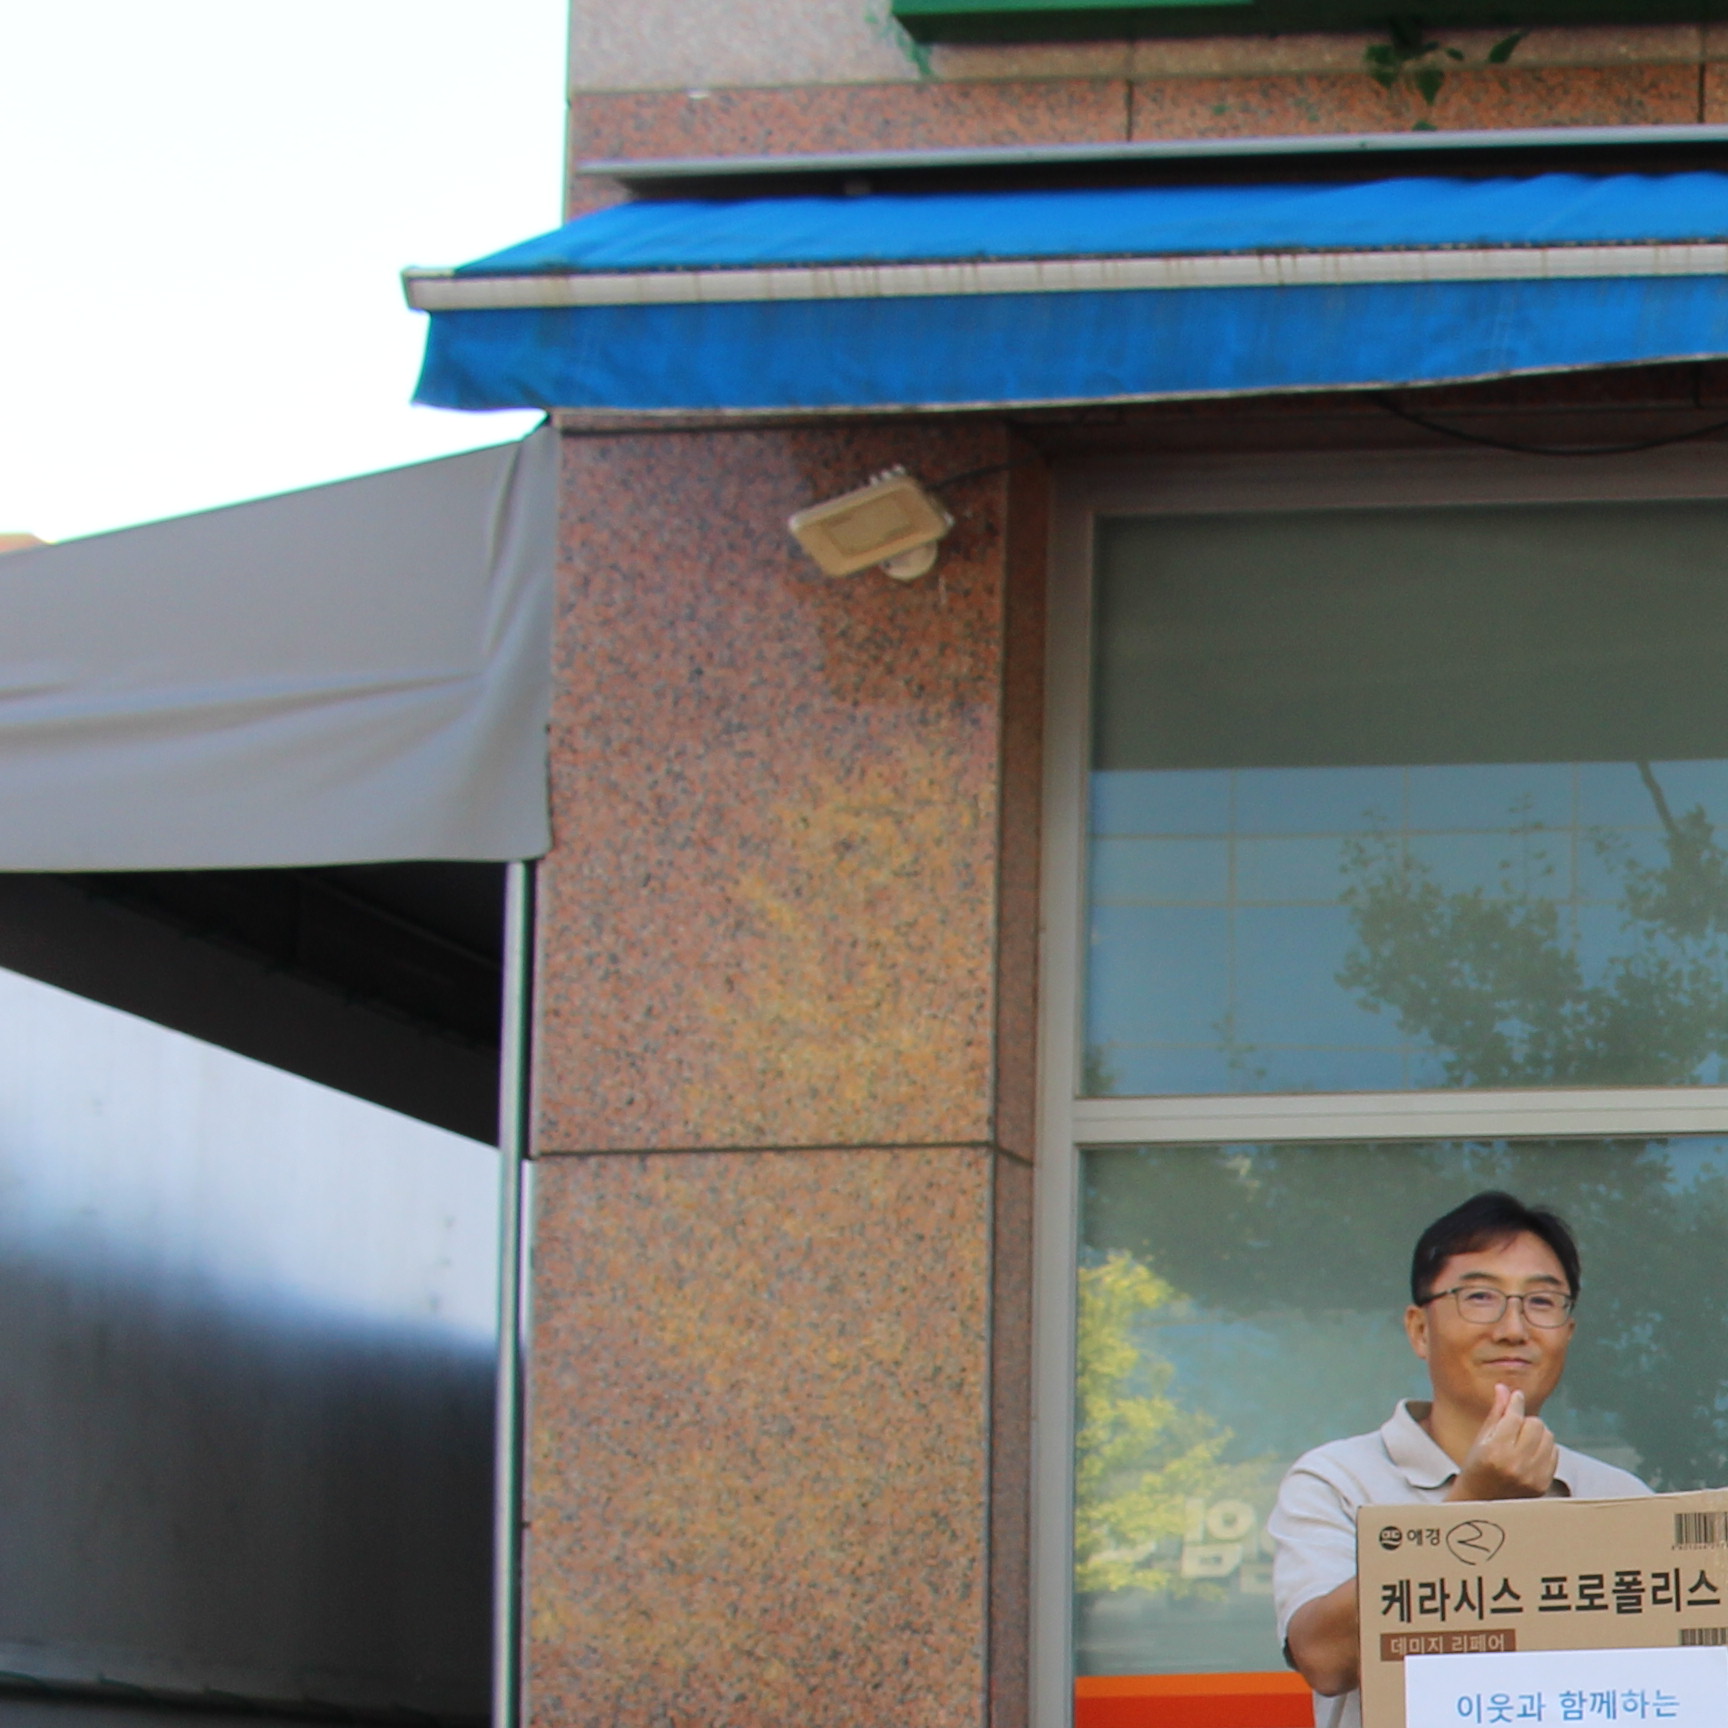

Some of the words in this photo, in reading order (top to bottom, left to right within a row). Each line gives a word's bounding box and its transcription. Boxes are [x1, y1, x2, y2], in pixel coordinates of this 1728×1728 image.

[1406, 1528, 1441, 1547] 애경
[1380, 1574, 1524, 1623] 케라시스
[1537, 1567, 1722, 1615] 프로폴리스
[1390, 1635, 1444, 1655] 데미지
[1450, 1633, 1506, 1653] 리페어
[1456, 1690, 1546, 1724] 이웃과
[1558, 1688, 1681, 1720] 함께하는
